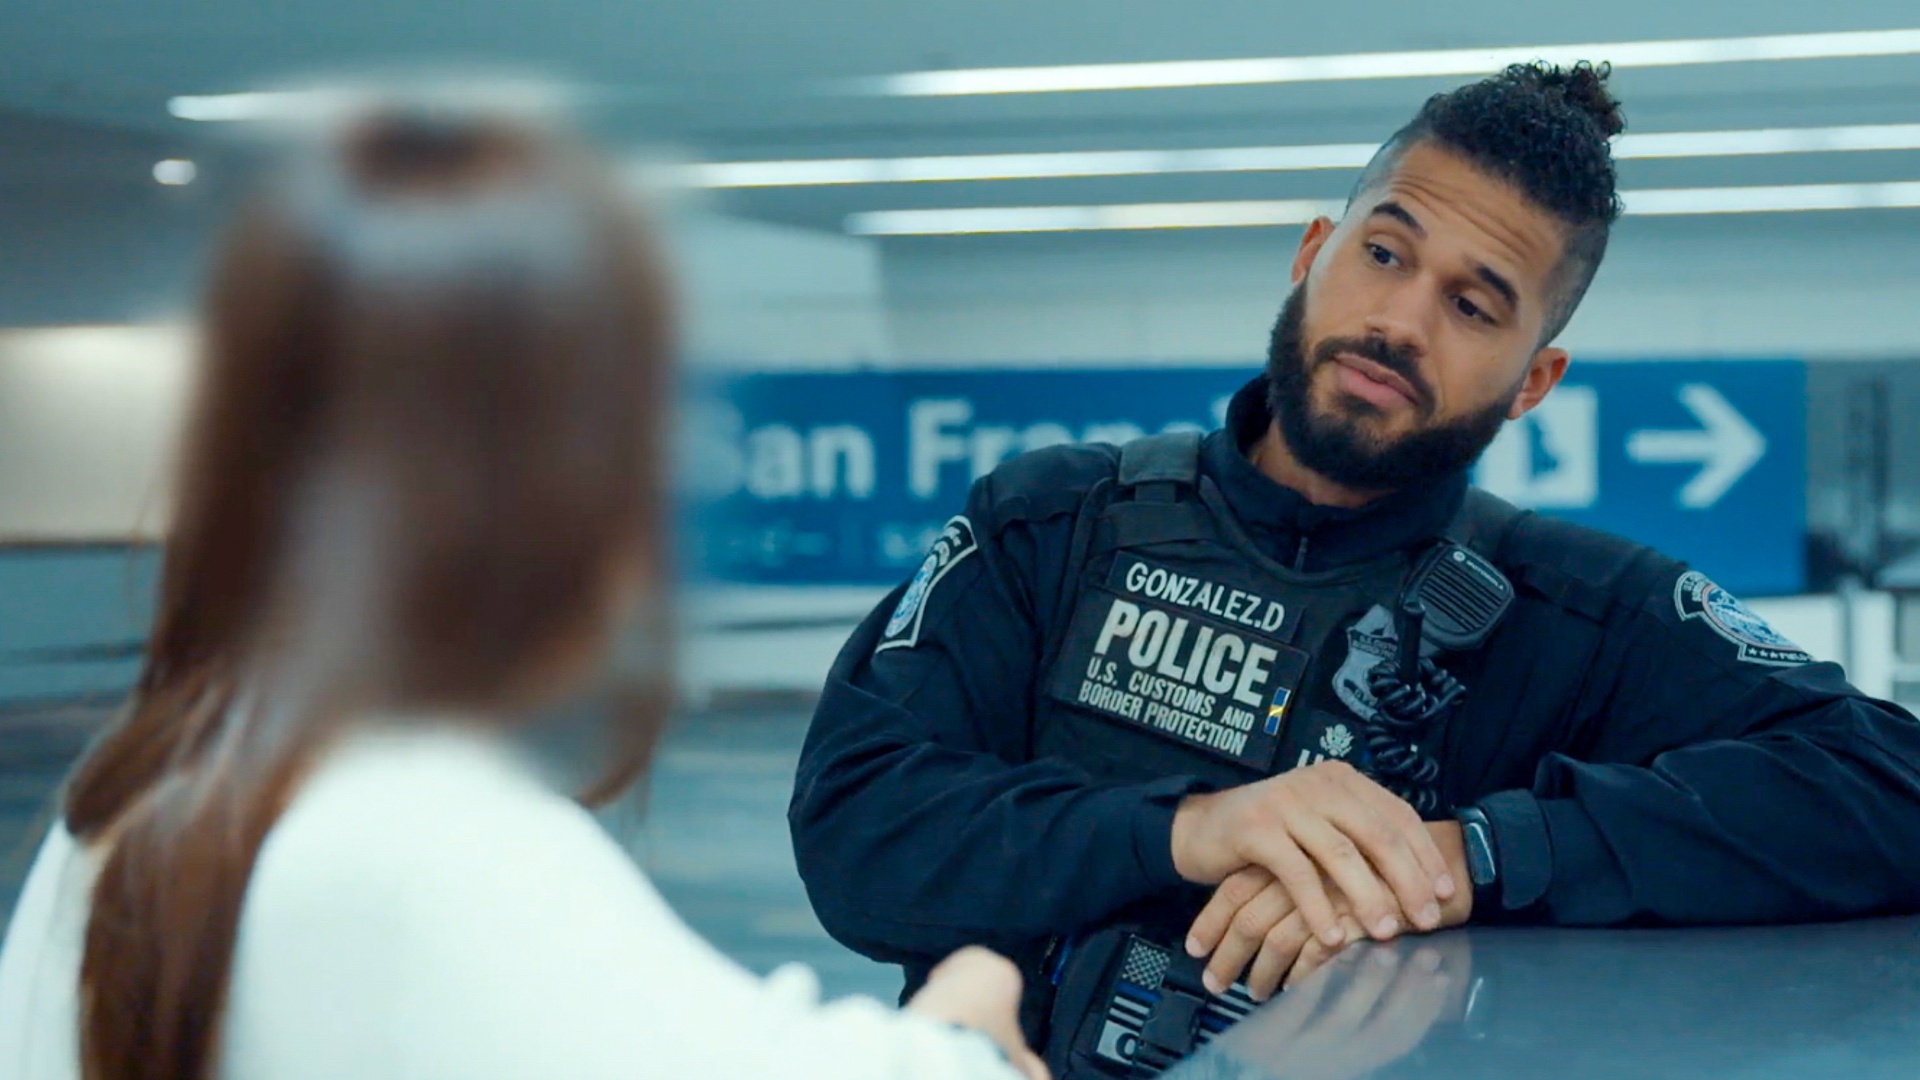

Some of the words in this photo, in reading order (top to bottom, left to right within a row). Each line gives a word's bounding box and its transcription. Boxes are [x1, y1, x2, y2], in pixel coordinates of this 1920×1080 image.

[1126, 562, 1285, 632] GONZALEZ.D
[1094, 599, 1278, 708] POLICE
[1078, 680, 1142, 721] BORDER
[1143, 701, 1248, 756] PROTECTION
[1086, 656, 1118, 686] U.S.
[1128, 670, 1217, 717] CUSTOMS
[1219, 705, 1255, 732] AND
